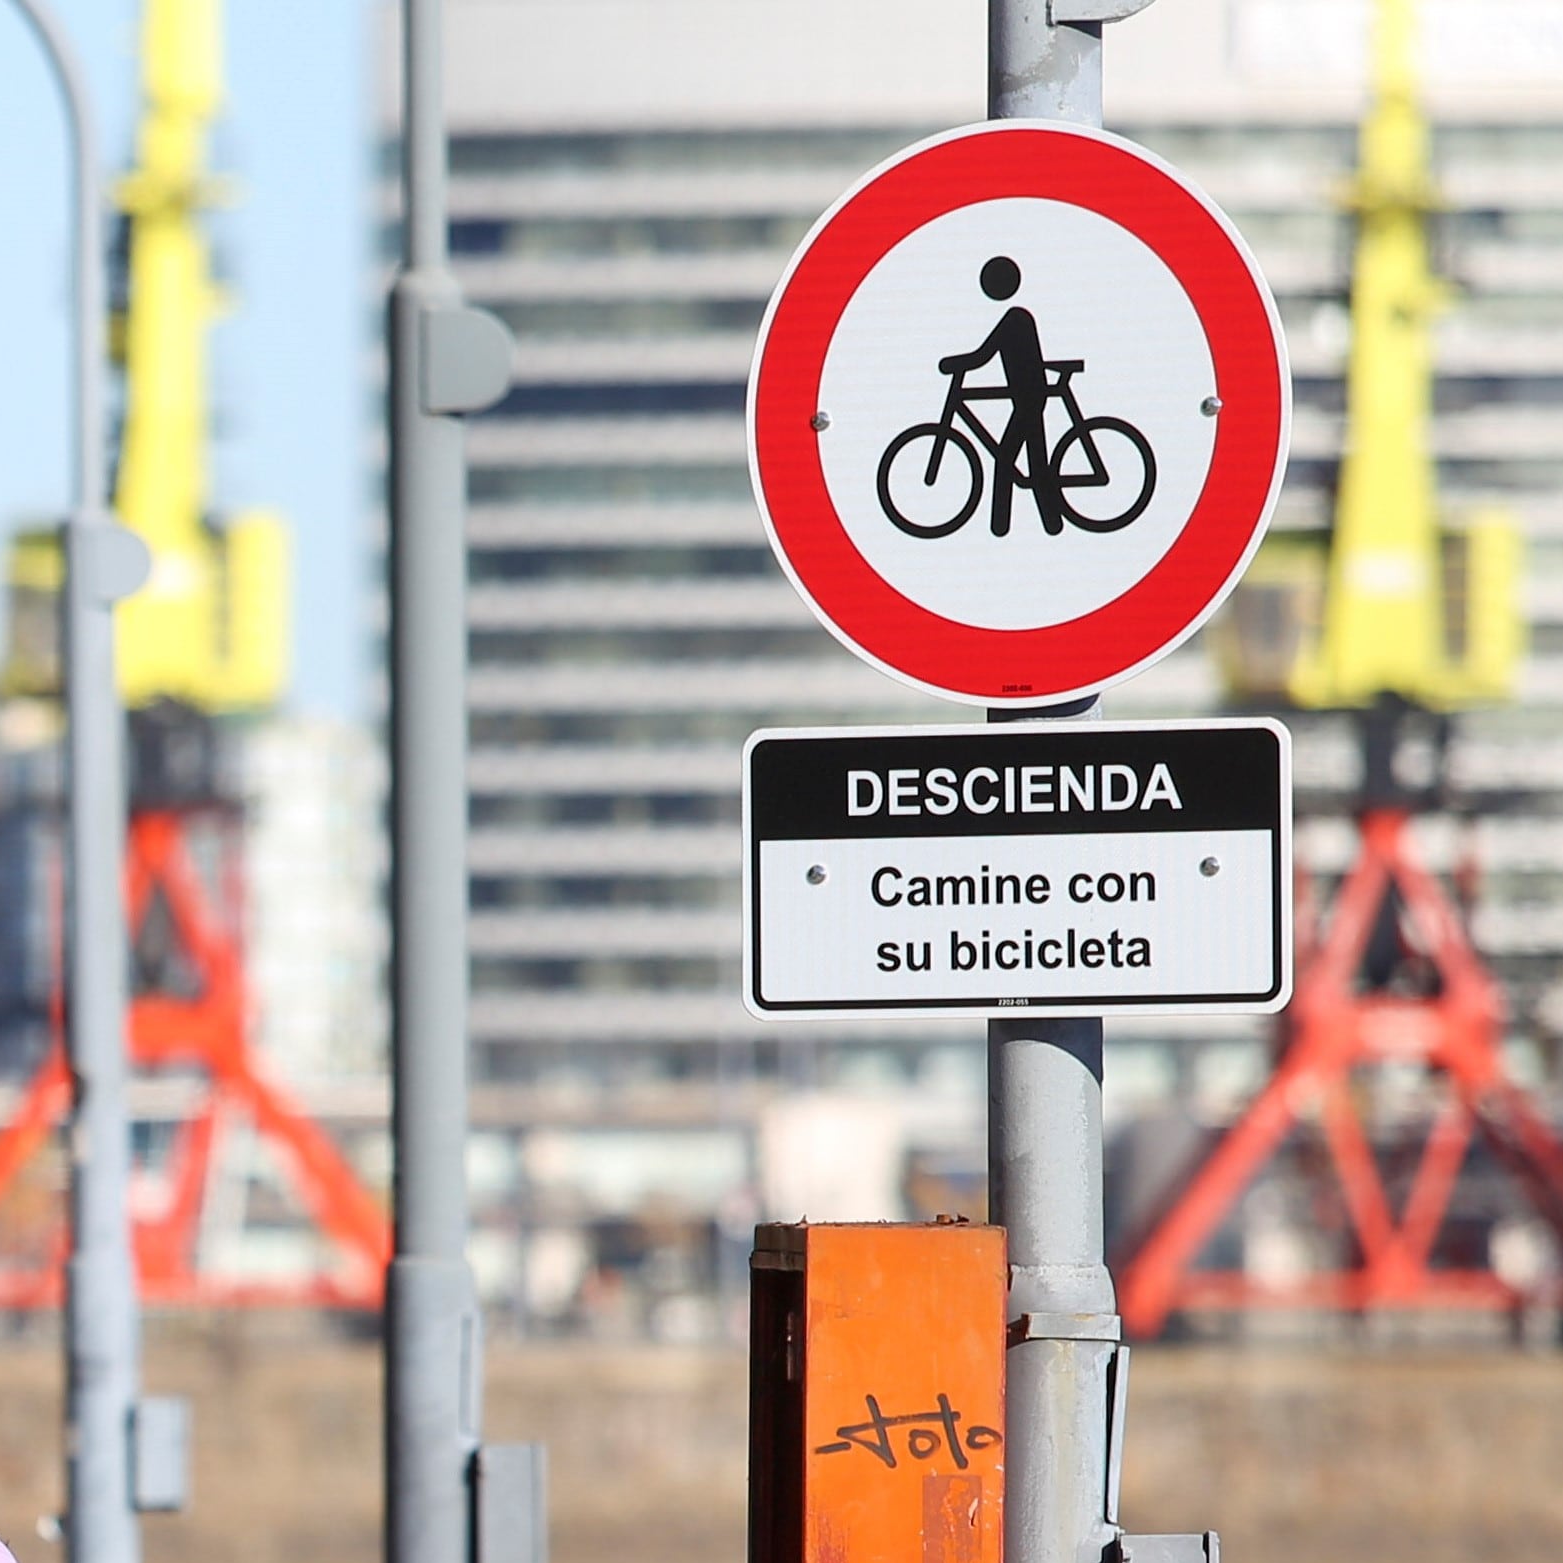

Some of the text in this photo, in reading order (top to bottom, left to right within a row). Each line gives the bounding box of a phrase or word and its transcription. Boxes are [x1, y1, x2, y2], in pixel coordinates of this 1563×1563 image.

[847, 763, 1183, 817] DESCIENDA
[871, 865, 1156, 907] Camine con
[876, 929, 1152, 972] su bicicleta
